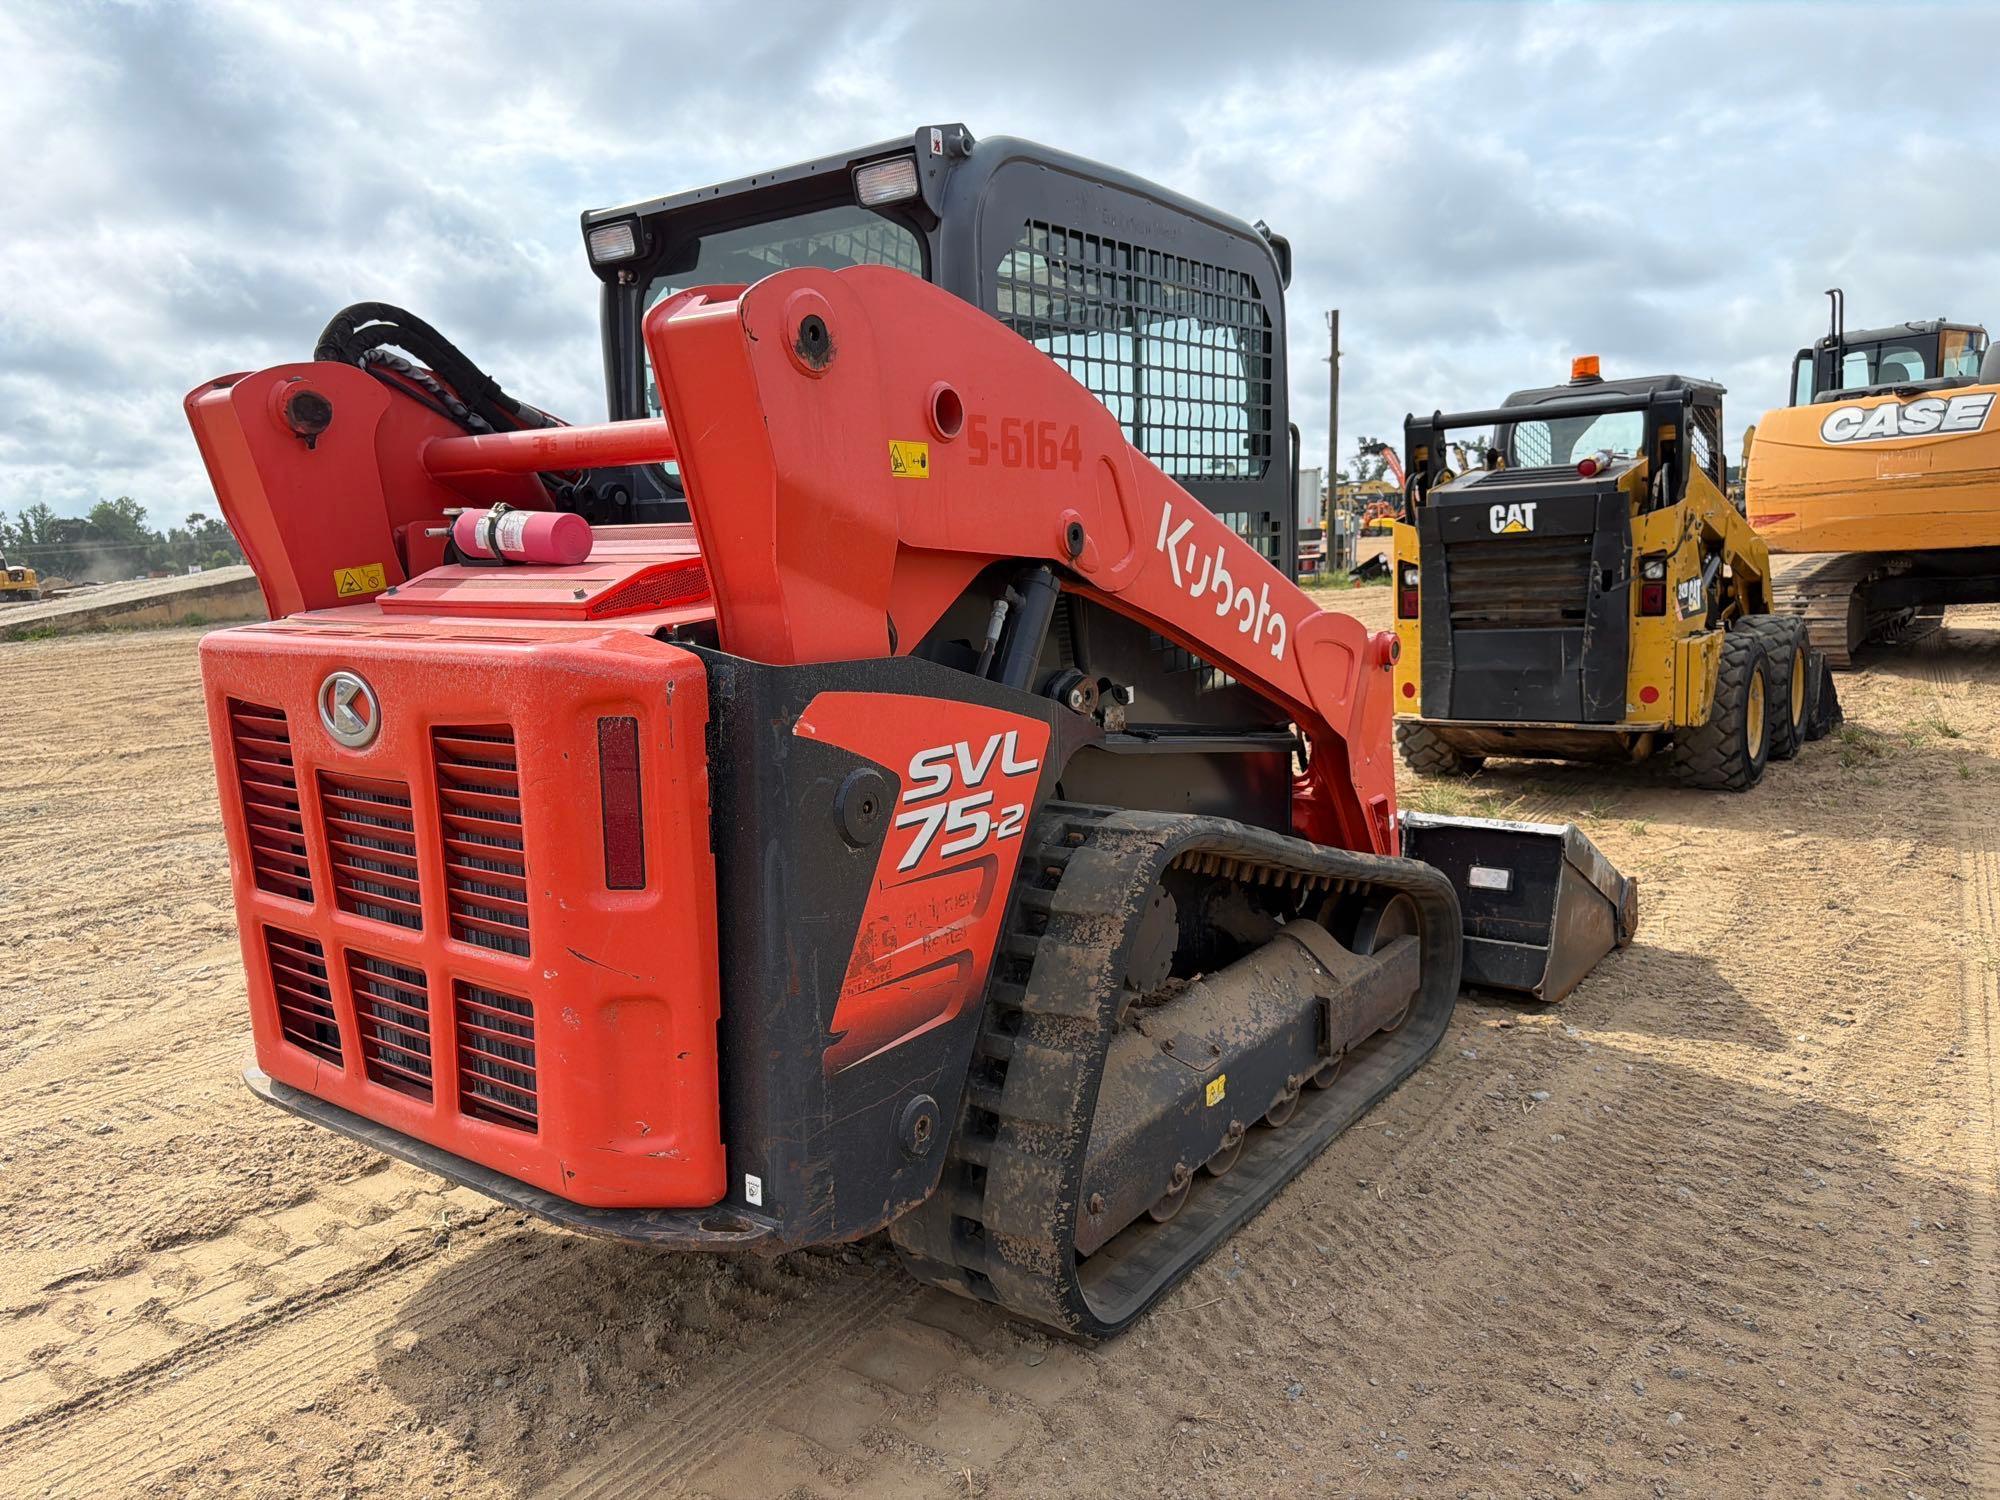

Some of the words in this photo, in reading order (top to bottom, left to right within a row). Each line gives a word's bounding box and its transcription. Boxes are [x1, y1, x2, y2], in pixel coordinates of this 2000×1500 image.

[1821, 393, 1993, 442] CASE
[1489, 502, 1537, 533] CAT
[1156, 501, 1286, 661] Kubota
[1689, 579, 1701, 611] CAT
[903, 730, 1038, 802] SVL
[895, 791, 1025, 870] 75-2
